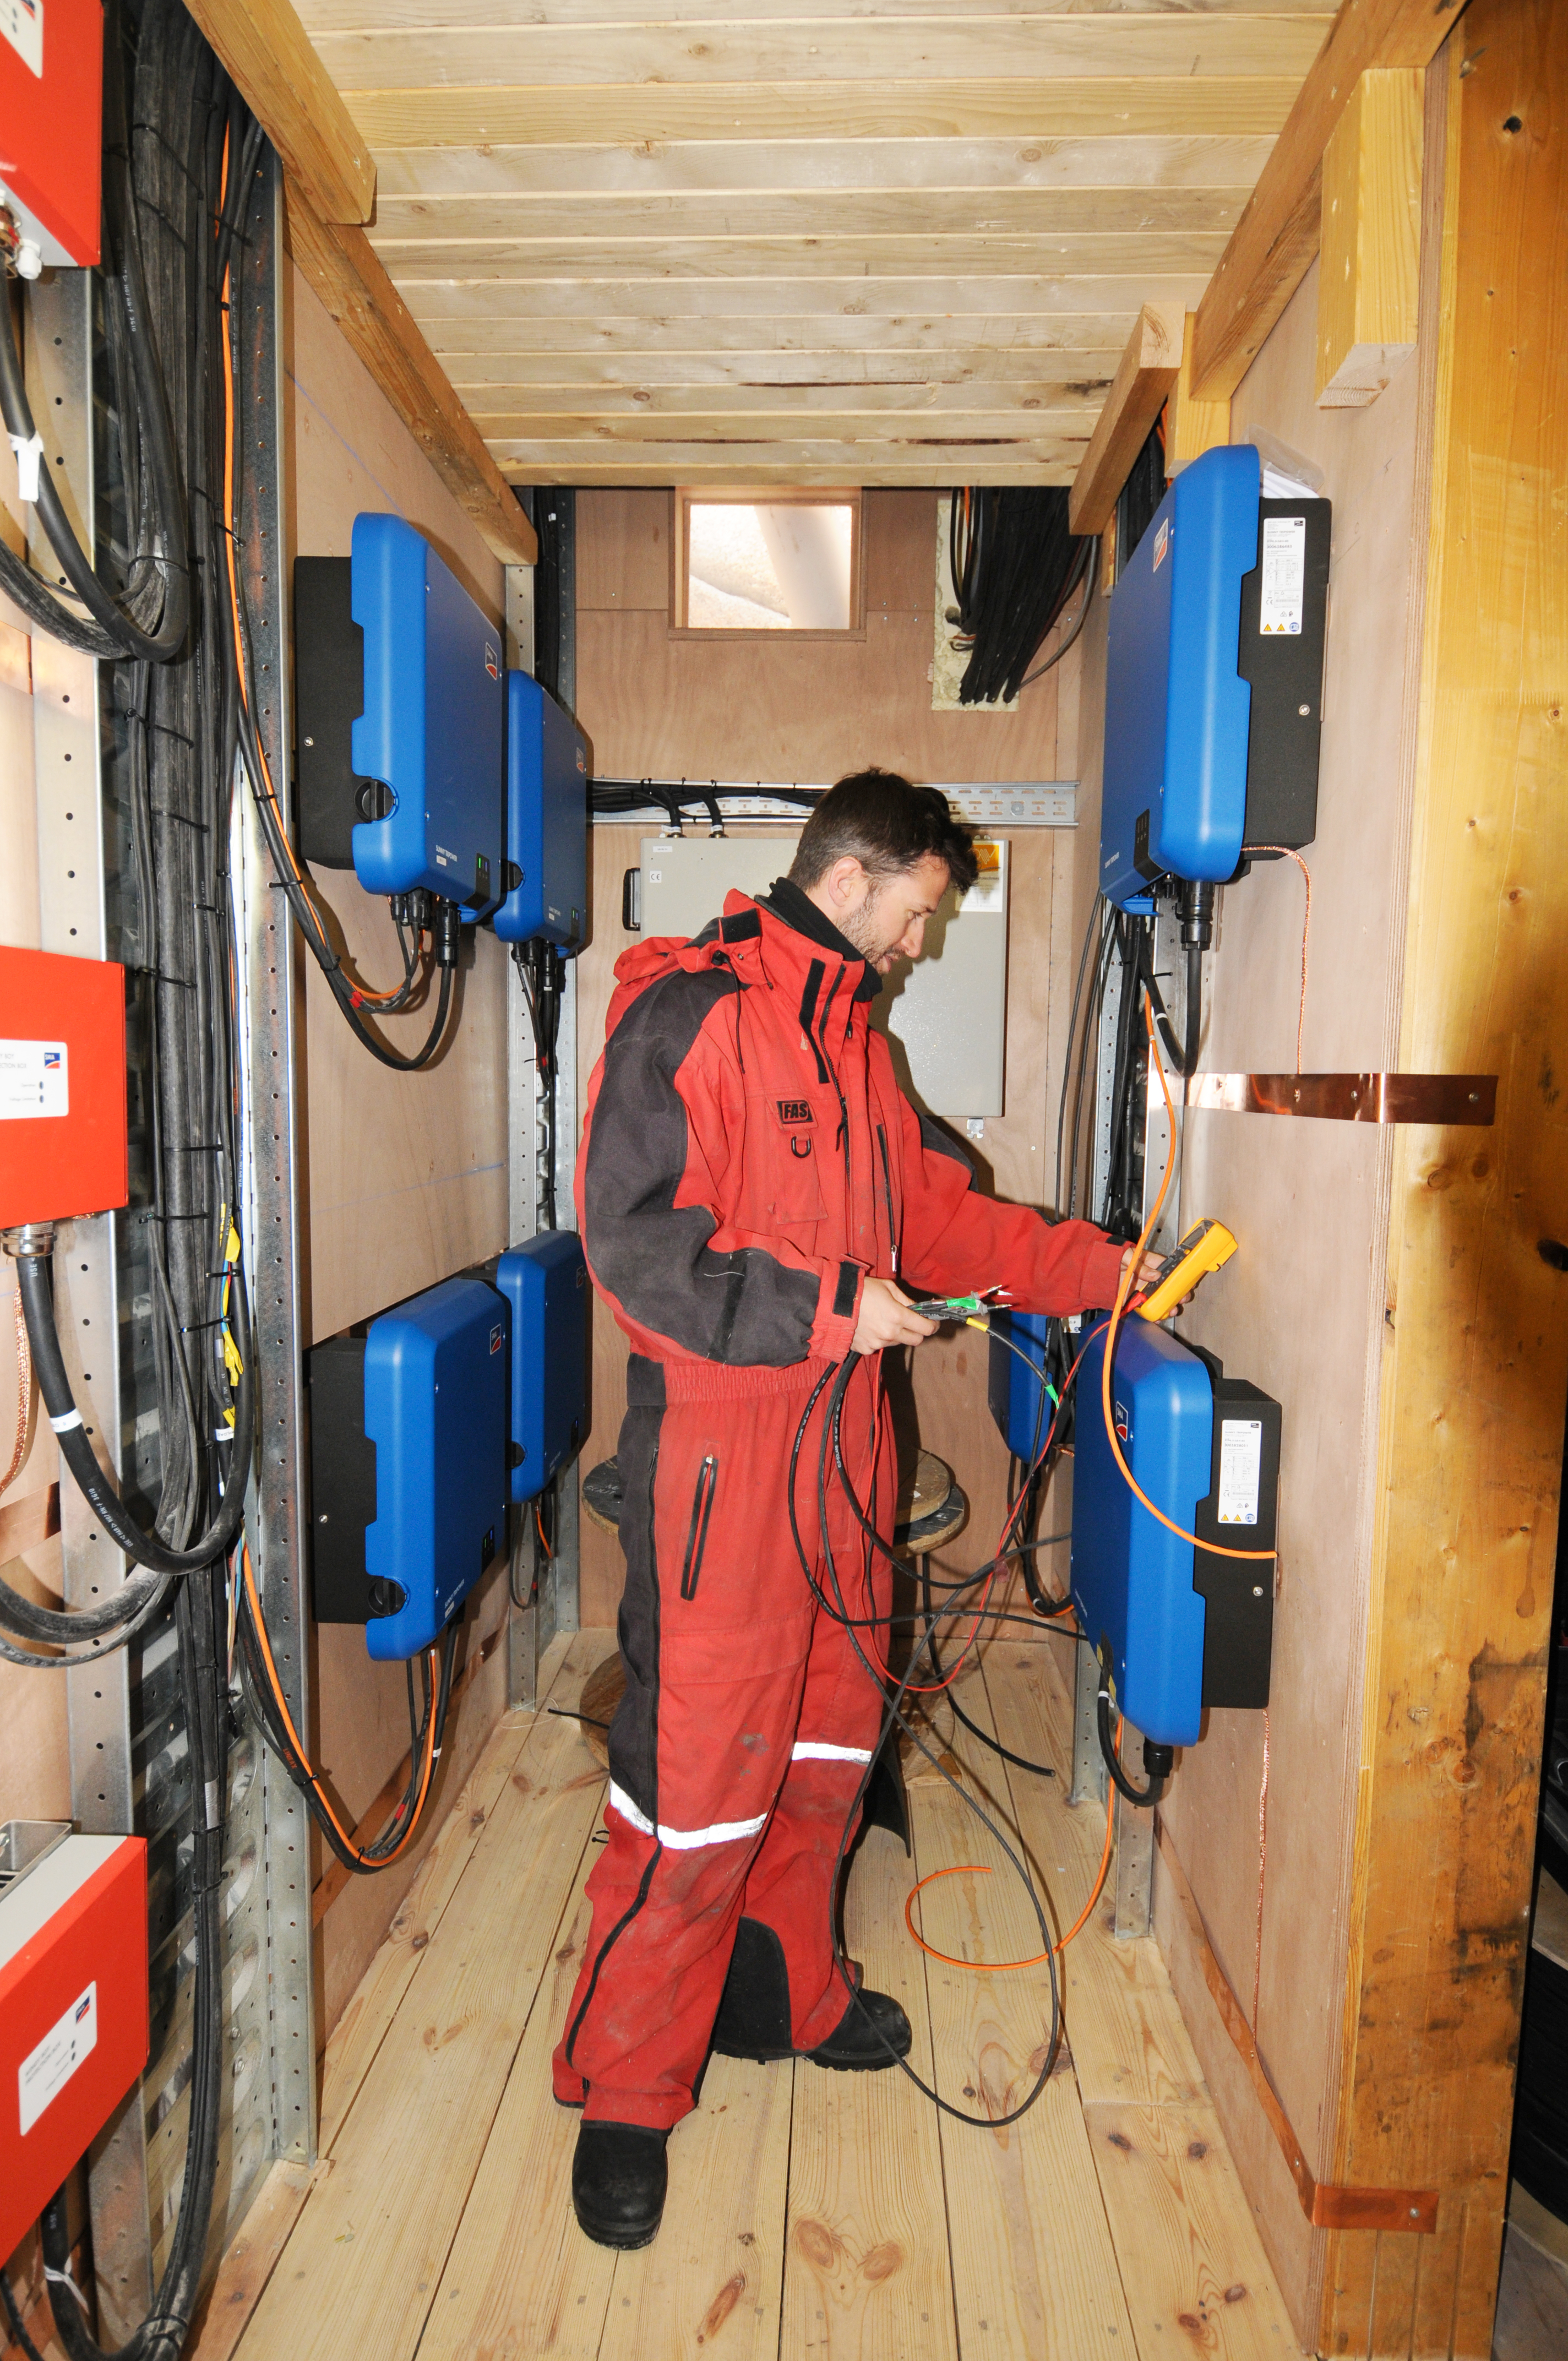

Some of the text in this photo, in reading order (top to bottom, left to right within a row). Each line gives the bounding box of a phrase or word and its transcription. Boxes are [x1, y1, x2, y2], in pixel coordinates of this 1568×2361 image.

[784, 1103, 808, 1119] FAS
[30, 1263, 38, 1277] USE
[88, 1488, 100, 1501] 3G10
[104, 1514, 114, 1523] H07
[123, 1539, 134, 1548] USE
